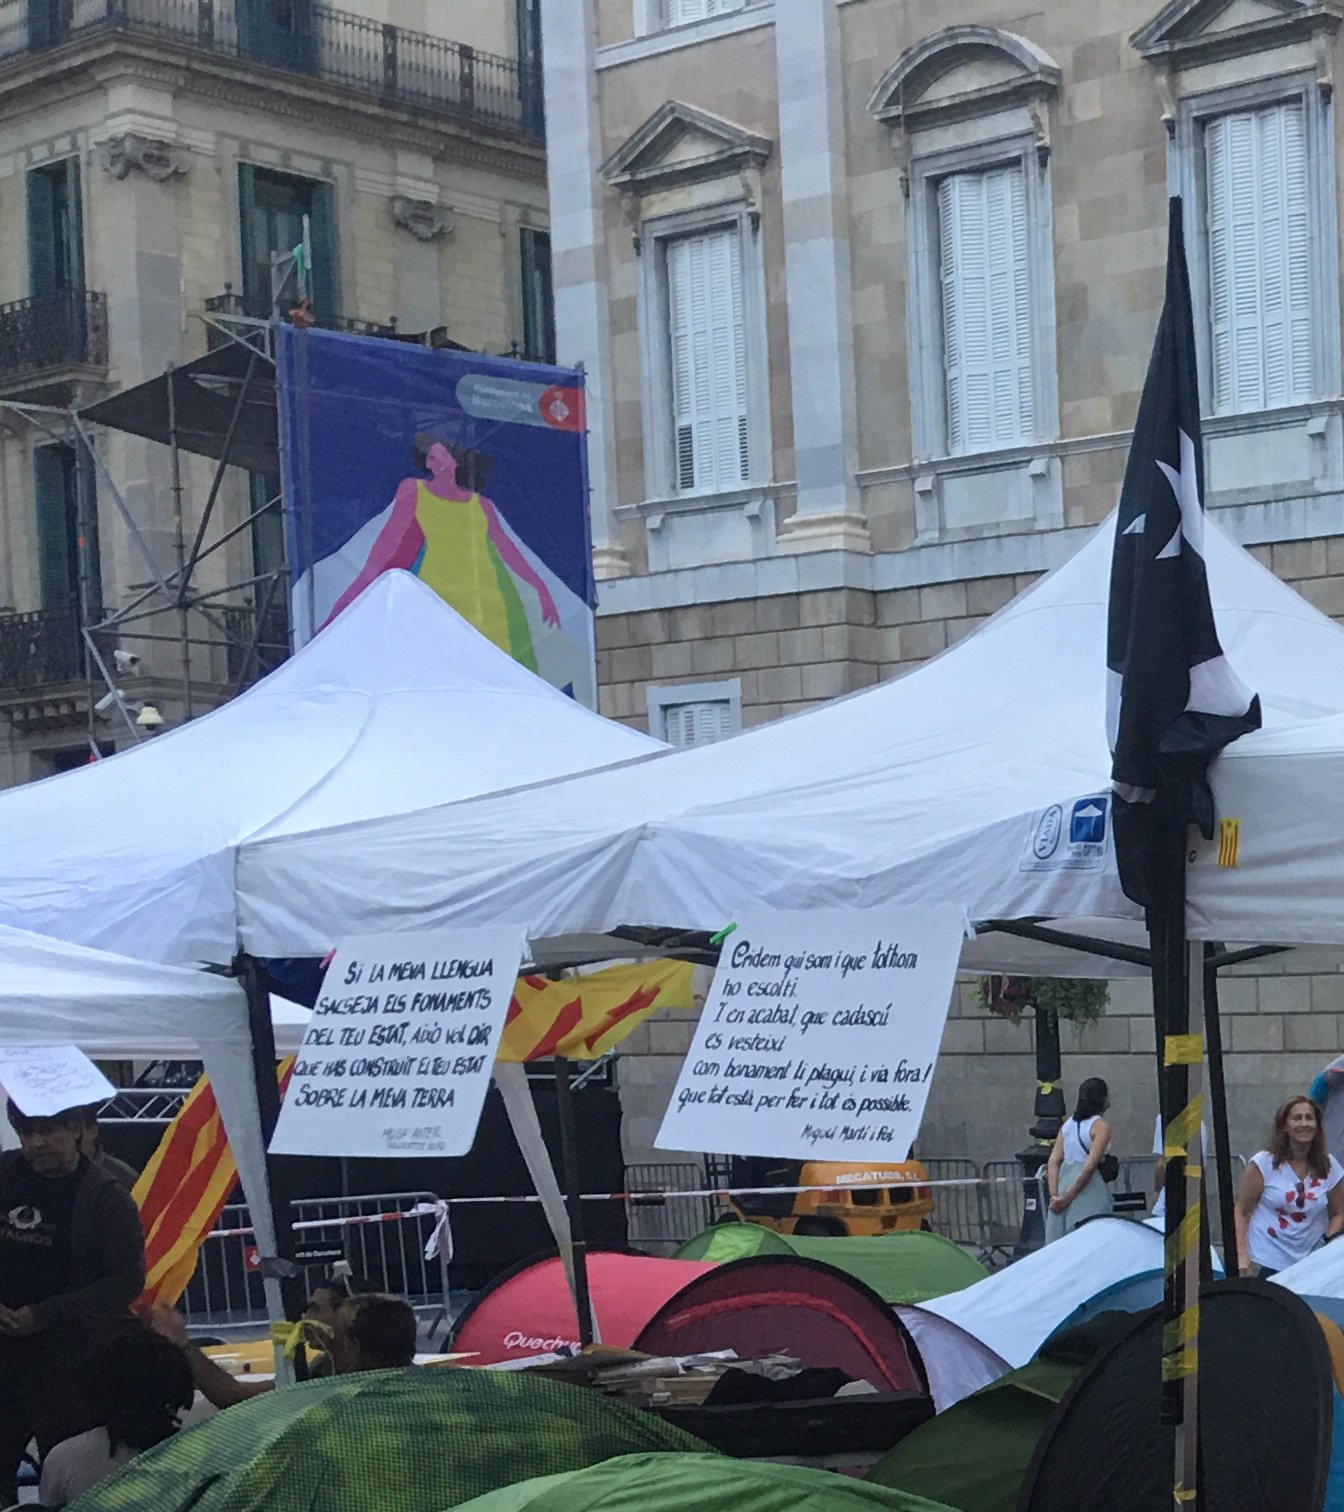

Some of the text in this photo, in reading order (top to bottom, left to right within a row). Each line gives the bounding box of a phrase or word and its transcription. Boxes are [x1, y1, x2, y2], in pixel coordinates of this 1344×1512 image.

[368, 964, 384, 983] LA
[388, 961, 425, 981] MEVA
[431, 959, 493, 980] LLENGUA
[730, 940, 918, 979] Cridem qui som i que tothom
[722, 978, 742, 997] ho
[315, 988, 491, 1015] SACSEJA ELS FONAMENTS
[713, 1002, 728, 1023] I
[727, 1009, 744, 1024] en
[800, 1011, 829, 1035] que
[832, 1003, 893, 1027] cadascú
[305, 1028, 335, 1046] DEL
[339, 1028, 366, 1046] TEU
[368, 1021, 411, 1047] ESTAT,
[705, 1032, 722, 1050] es
[294, 1060, 322, 1076] QUE
[322, 1057, 347, 1077] HAS
[452, 1055, 487, 1075] ESTAT
[693, 1060, 720, 1077] com
[725, 1056, 792, 1080] bonament
[794, 1060, 805, 1080] li
[859, 1065, 866, 1082] i
[870, 1065, 889, 1083] via
[893, 1059, 933, 1083] fora!
[349, 1089, 368, 1108] LA
[370, 1088, 408, 1109] MEVA
[411, 1087, 454, 1109] TERRA
[708, 1084, 725, 1103] tot
[725, 1088, 754, 1107] està
[754, 1094, 786, 1112] per
[786, 1087, 808, 1109] fer
[810, 1092, 818, 1108] i
[819, 1092, 839, 1110] tot
[839, 1125, 866, 1142] Martí
[868, 1125, 878, 1142] i
